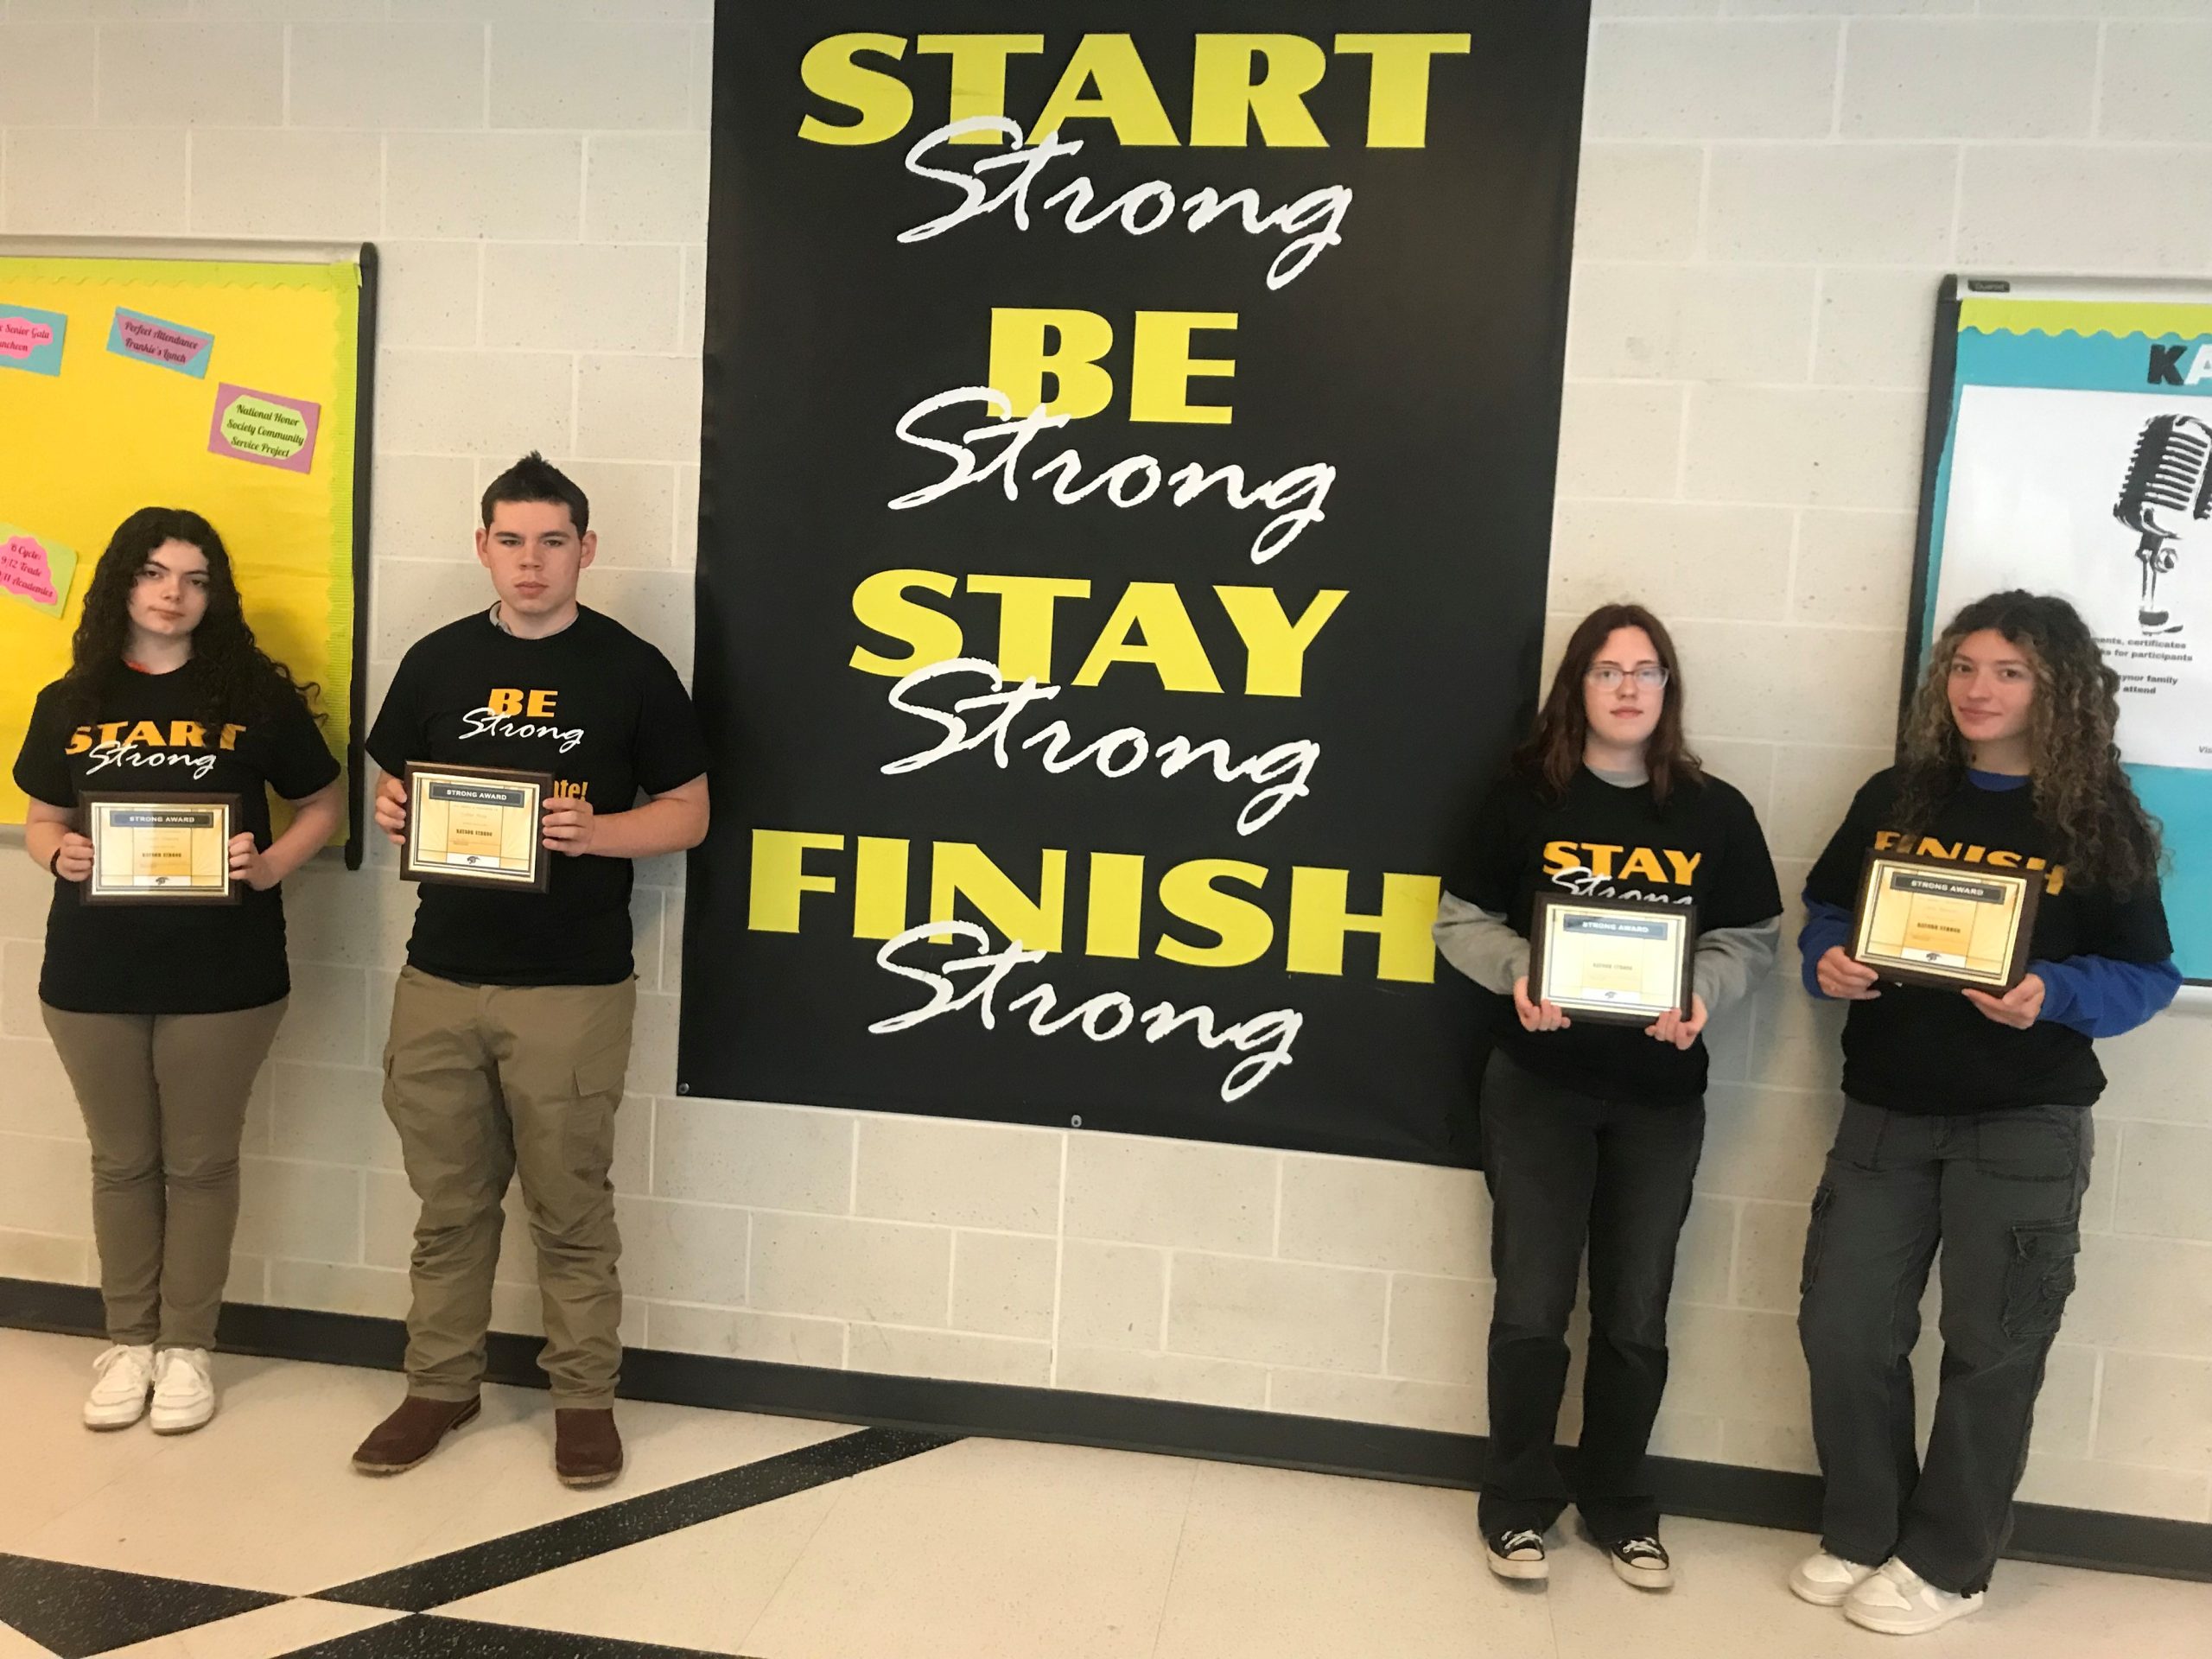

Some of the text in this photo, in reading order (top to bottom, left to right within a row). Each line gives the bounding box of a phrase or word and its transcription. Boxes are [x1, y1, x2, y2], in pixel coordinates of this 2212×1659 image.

[798, 33, 1471, 149] START
[897, 116, 1353, 291] Strong
[124, 321, 198, 349] Perfect Attendance
[125, 338, 187, 363] Frankie's Lunch
[988, 307, 1239, 424] BE
[237, 404, 300, 427] National Honor
[226, 418, 304, 447] Society Community
[231, 436, 290, 458] Service Project
[888, 385, 1337, 565] Strong
[12, 577, 54, 597] Academics
[849, 569, 1347, 698] STAY
[2127, 639, 2187, 650] certificates
[2131, 652, 2193, 662] participants
[2146, 675, 2178, 686] family
[487, 688, 558, 718] BE
[459, 707, 585, 754] Strong
[86, 740, 217, 780] Strong
[880, 657, 1320, 836] Strong
[446, 789, 478, 798] STRONG
[1542, 841, 1702, 887] STAY
[1910, 880, 1985, 896] STRONG AWARD
[748, 829, 1442, 983] FINISH
[868, 920, 1303, 1102] Strong
